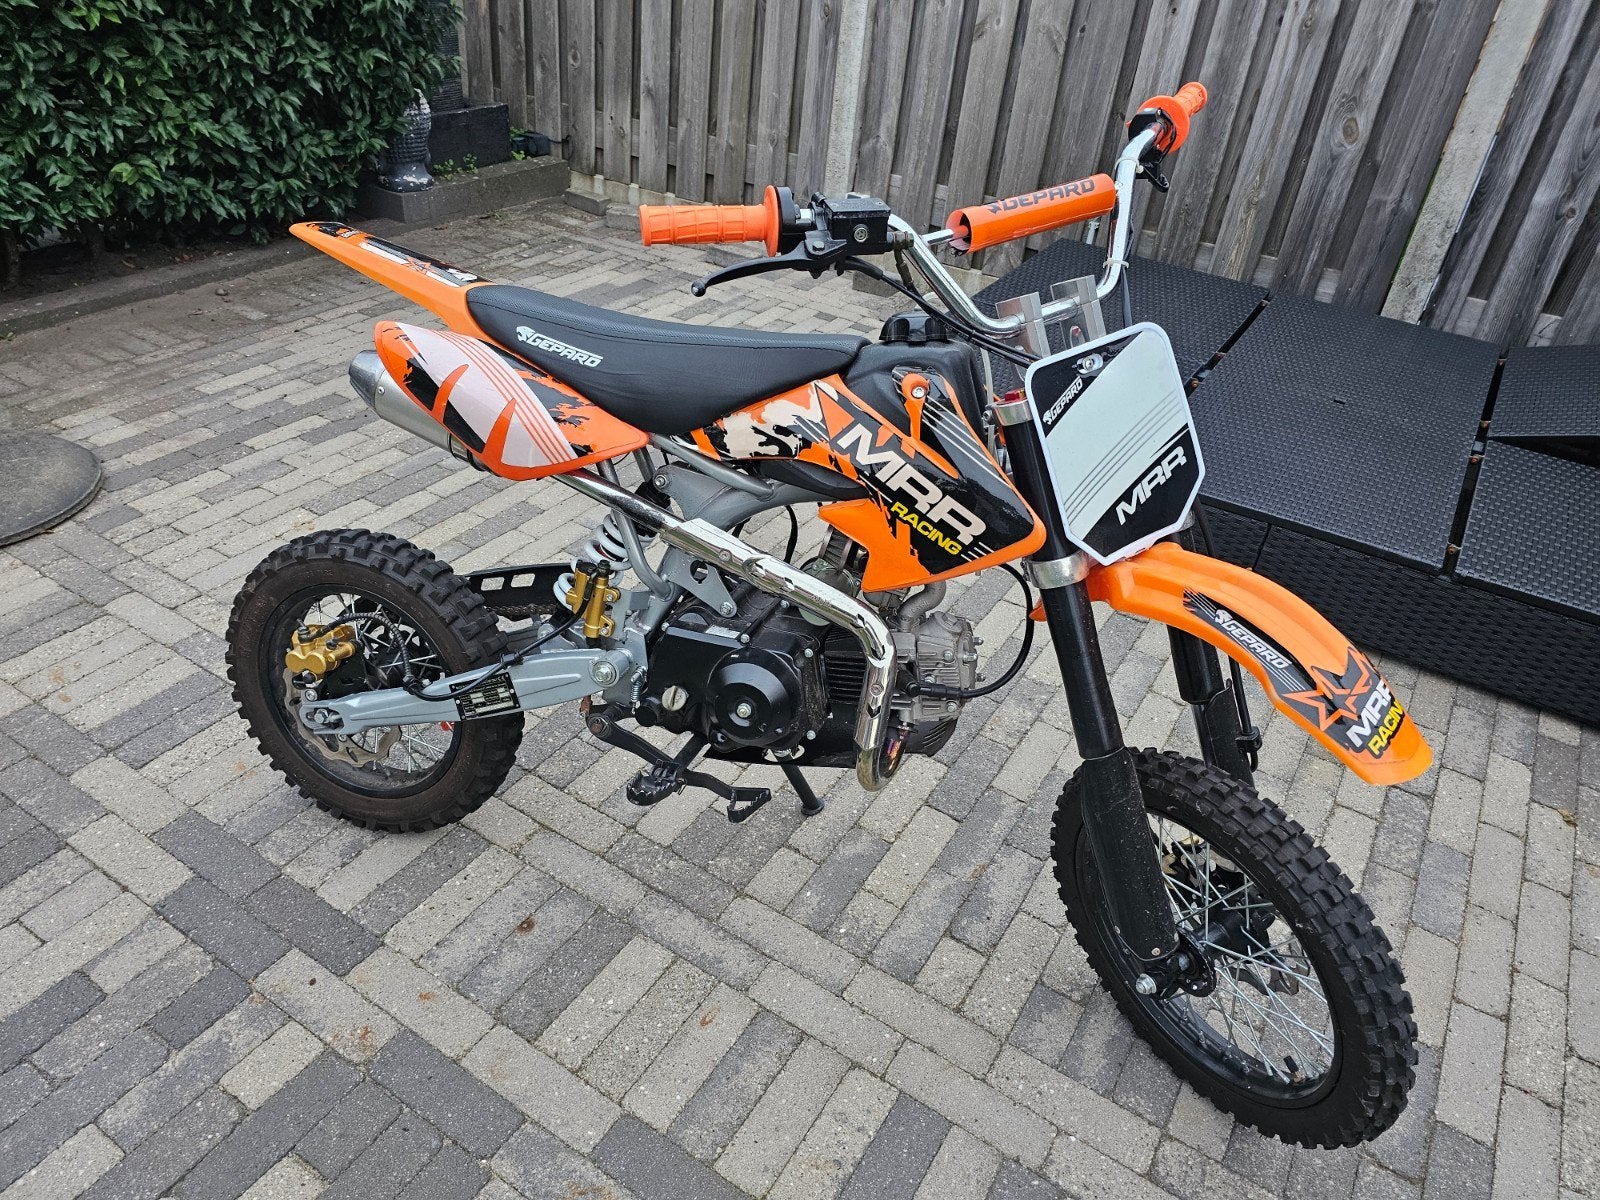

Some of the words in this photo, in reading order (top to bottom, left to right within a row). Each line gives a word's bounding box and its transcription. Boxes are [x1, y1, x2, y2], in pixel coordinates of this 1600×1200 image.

[1002, 179, 1095, 211] GEPARD
[531, 334, 603, 367] GEPARD
[1051, 379, 1083, 422] GEPARD
[838, 423, 986, 546] MRR
[1116, 446, 1187, 525] MRR
[891, 501, 962, 555] RACING
[1223, 619, 1291, 669] GEPARD
